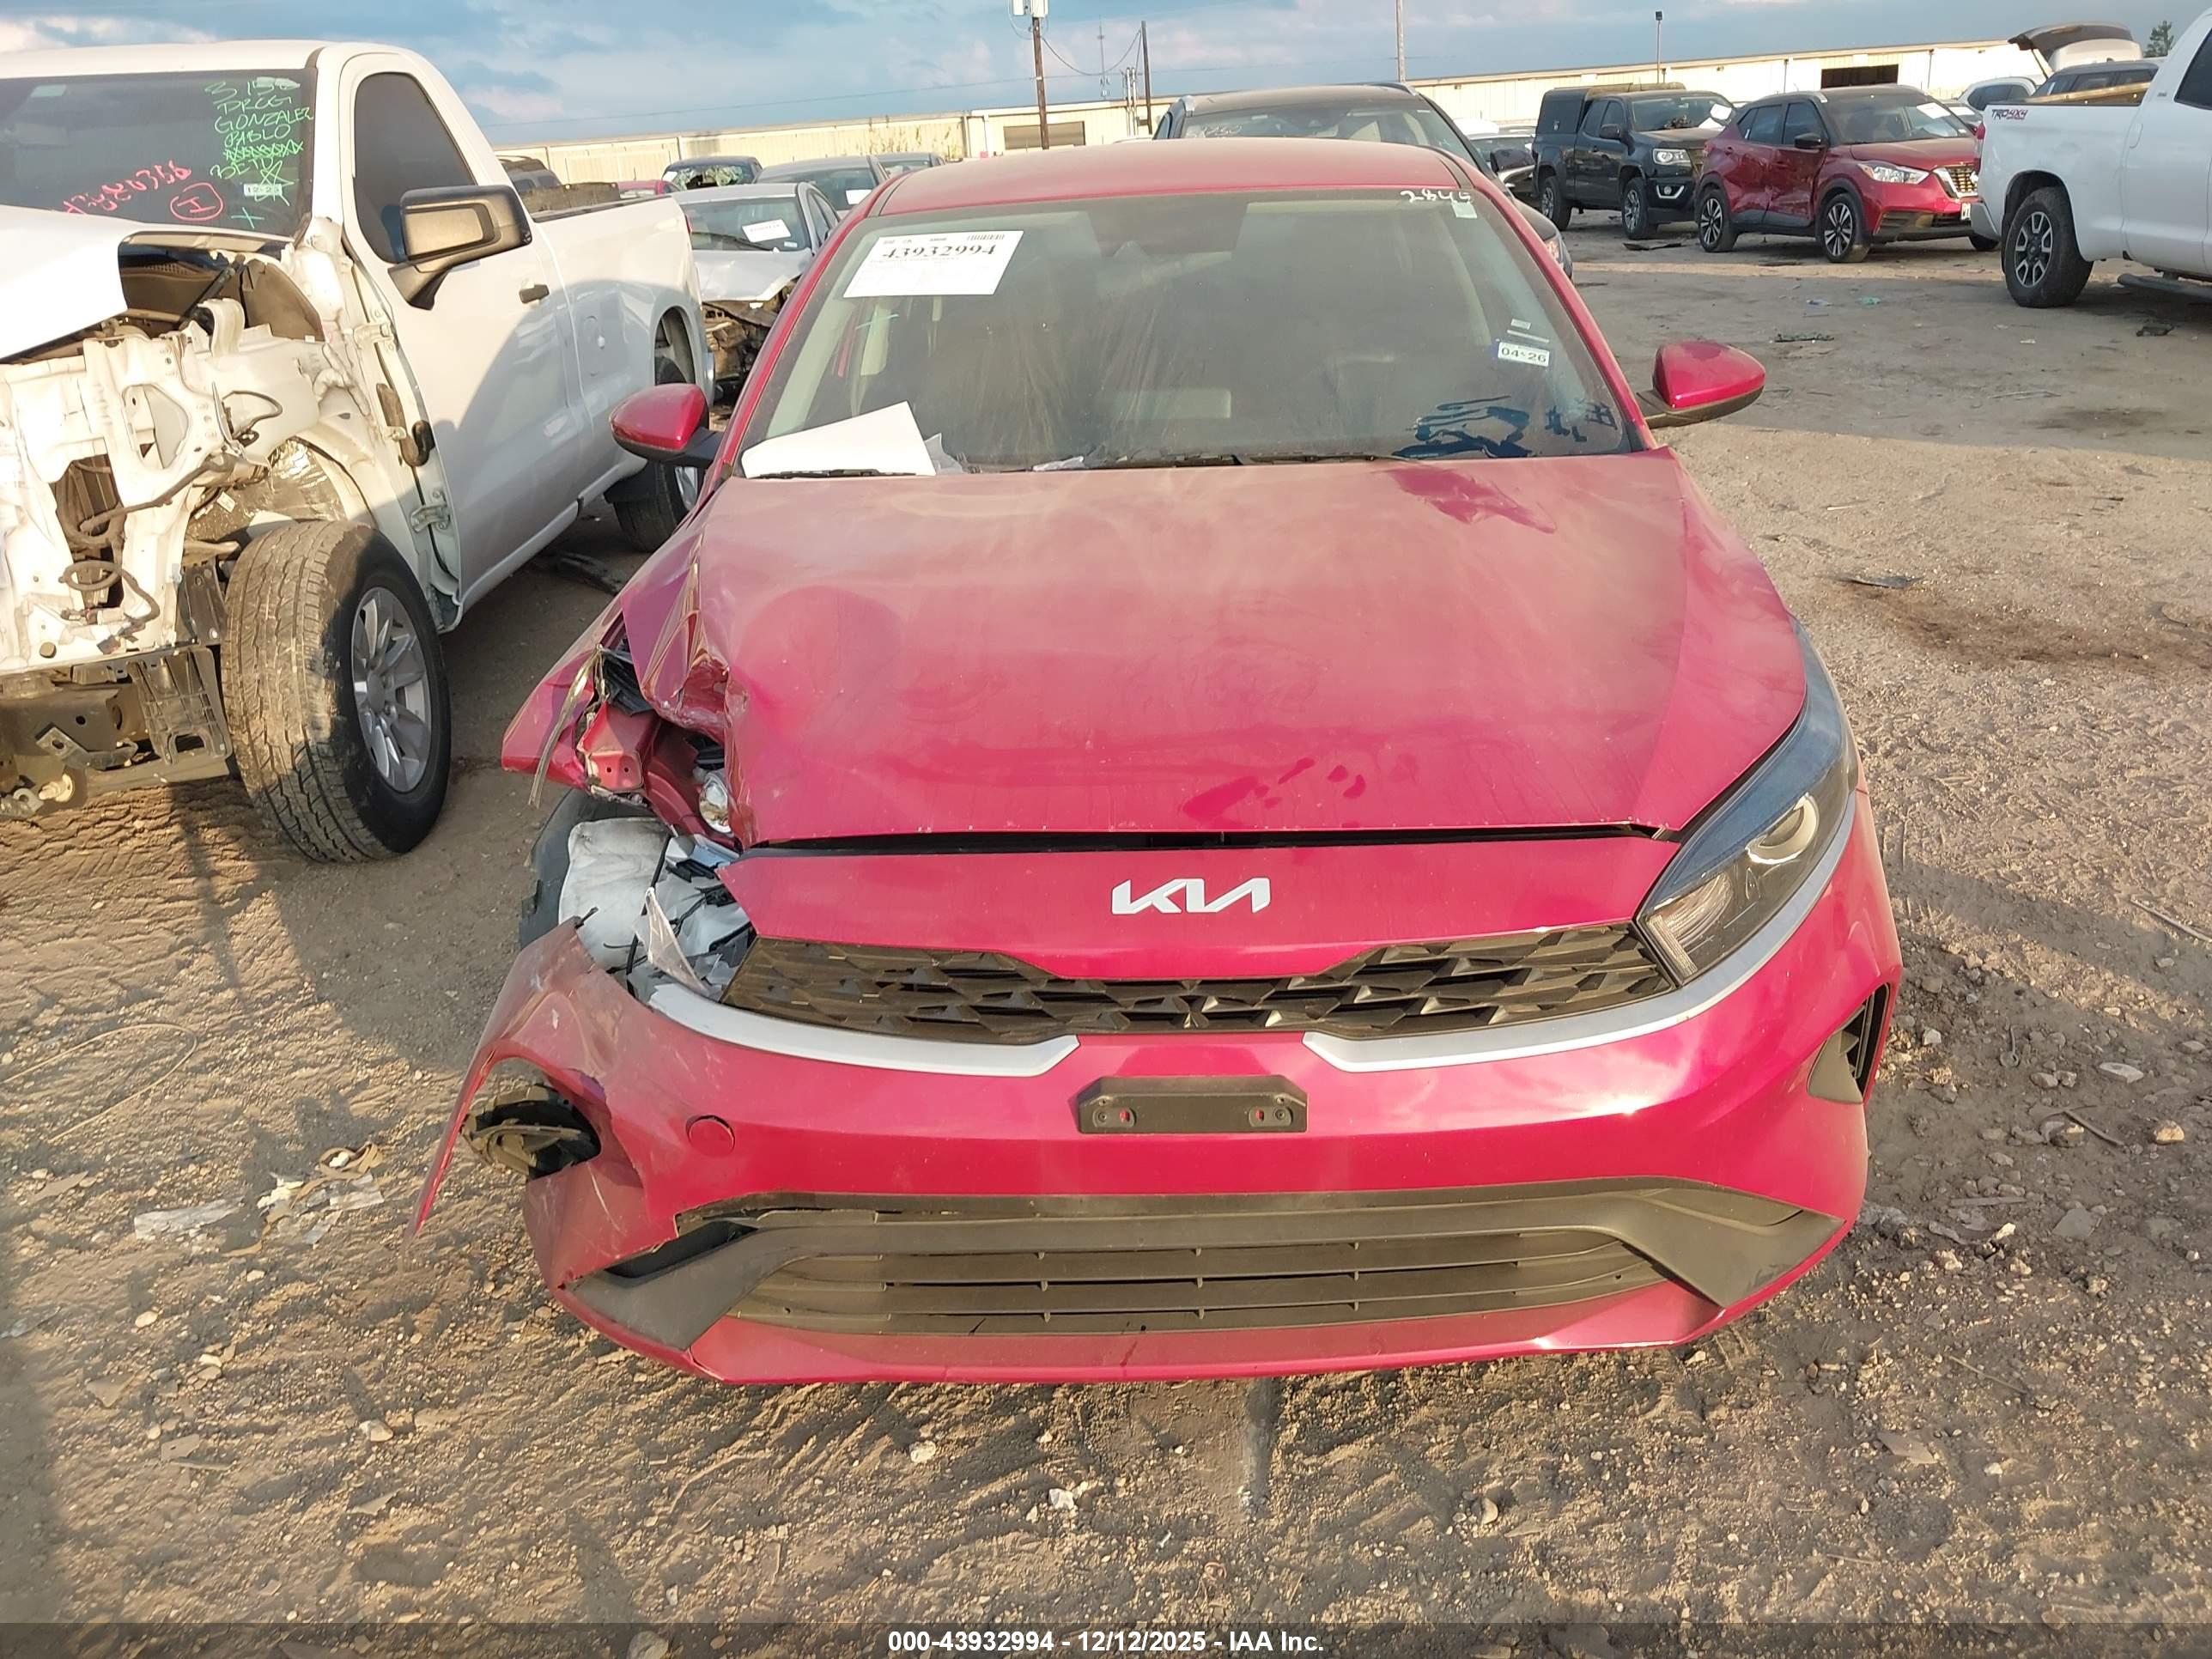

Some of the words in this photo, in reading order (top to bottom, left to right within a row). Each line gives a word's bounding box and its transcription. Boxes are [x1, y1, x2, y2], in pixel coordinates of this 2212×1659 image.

[883, 244, 997, 258] 43932994
[1501, 347, 1519, 357] 04
[1528, 352, 1547, 362] 26
[1111, 877, 1271, 914] KIA
